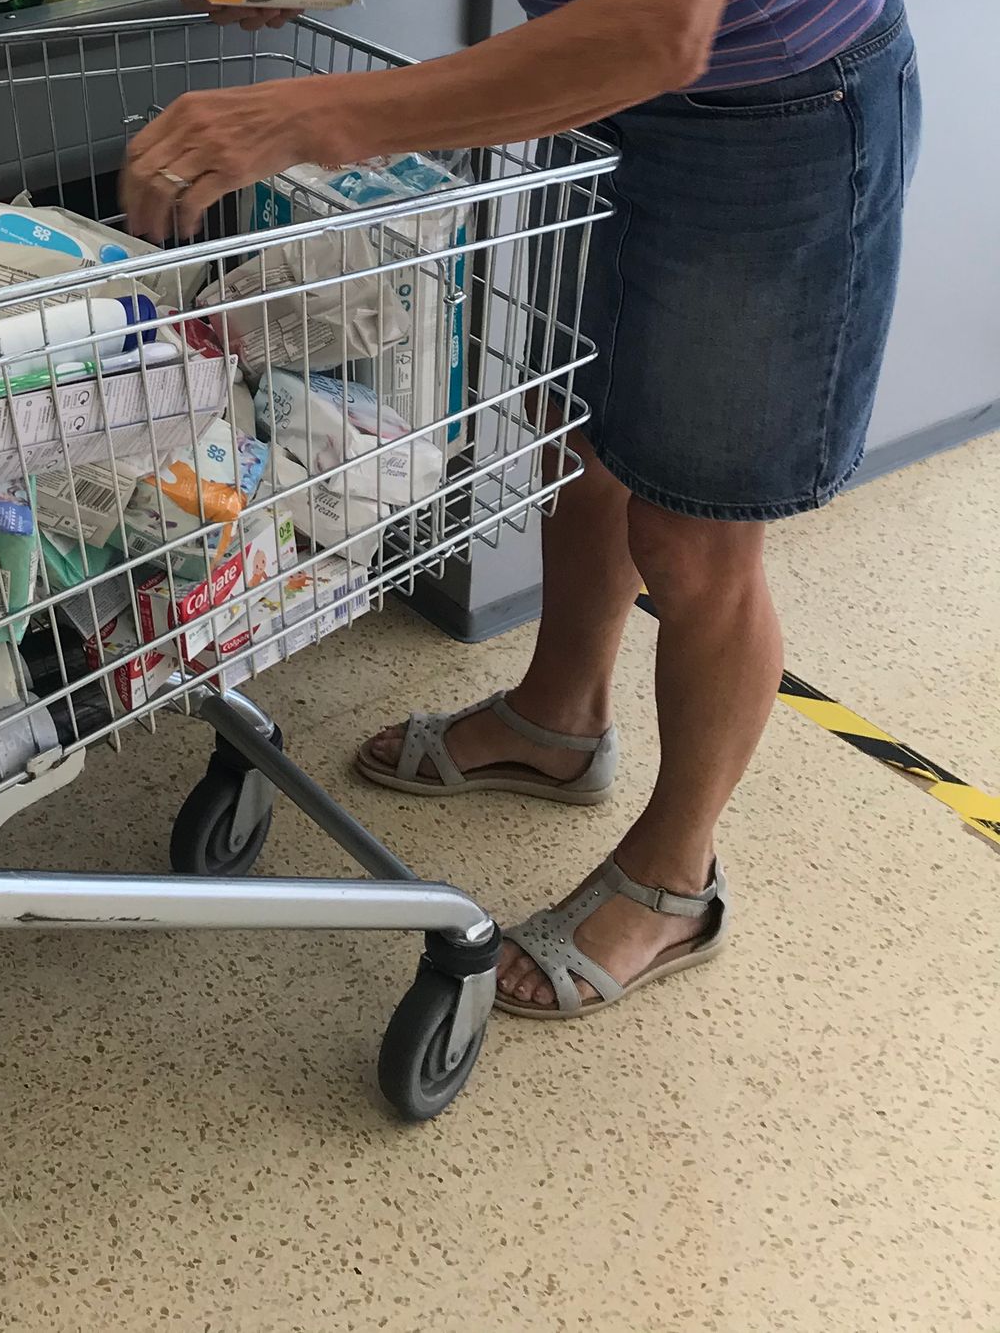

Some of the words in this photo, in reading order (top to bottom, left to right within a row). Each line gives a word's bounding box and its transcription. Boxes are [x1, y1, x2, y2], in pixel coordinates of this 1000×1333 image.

[308, 500, 341, 522] ream
[279, 520, 292, 539] 0-2
[186, 562, 238, 616] Colate
[119, 664, 130, 703] olgate
